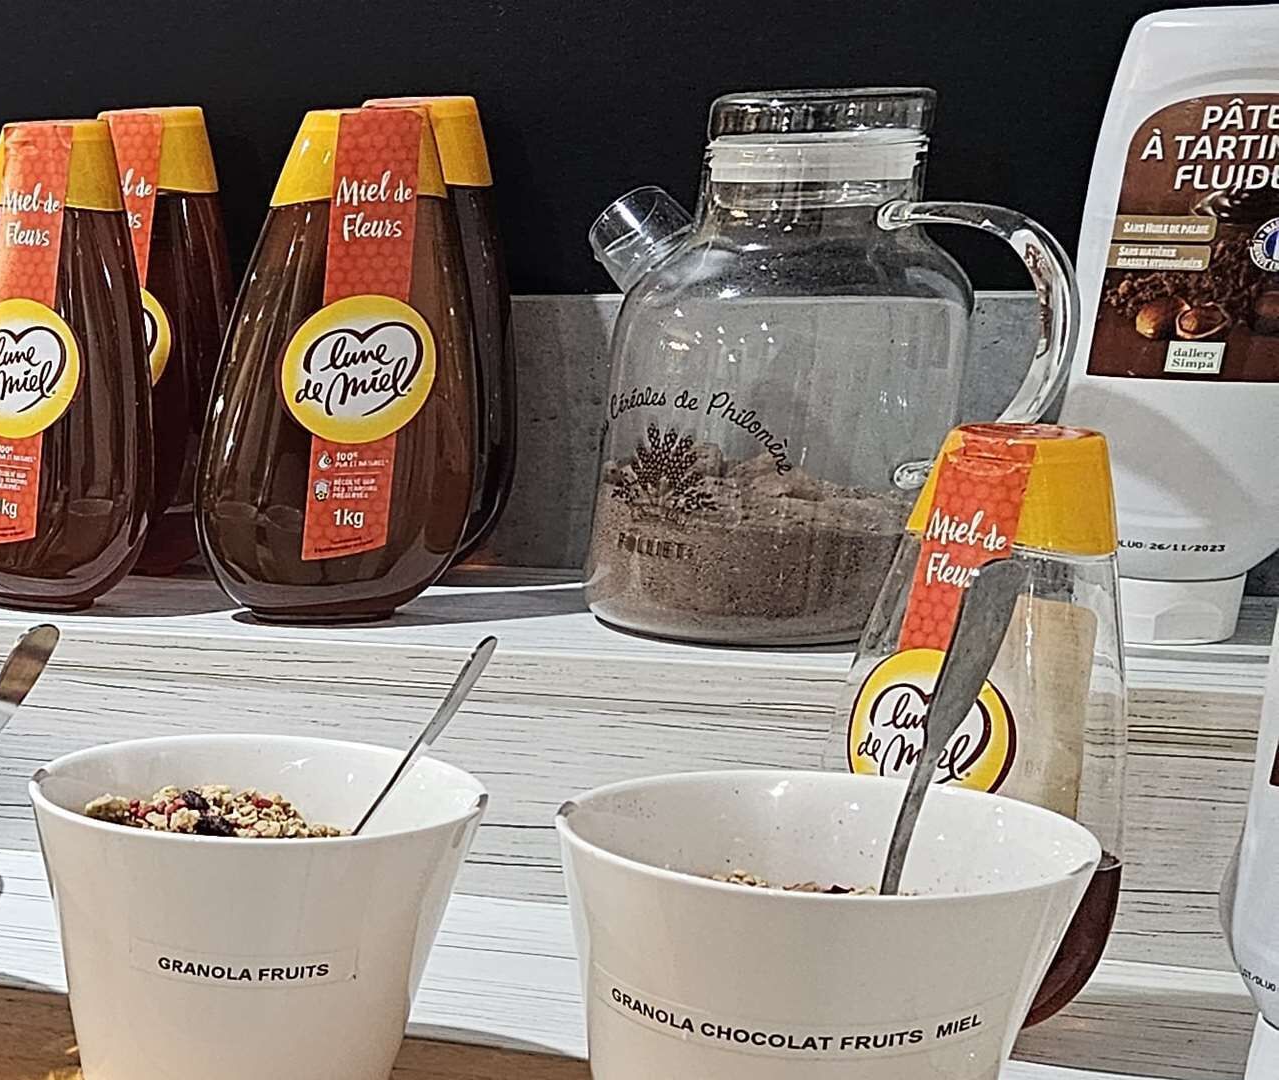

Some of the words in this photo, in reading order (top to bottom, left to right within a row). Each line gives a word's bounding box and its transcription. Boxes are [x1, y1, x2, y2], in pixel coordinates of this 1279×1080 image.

[1201, 97, 1279, 130] PÂTE
[1140, 127, 1164, 160] À
[1, 182, 41, 215] Miel
[43, 193, 61, 213] de
[134, 174, 154, 198] de
[336, 171, 391, 208] Miel
[393, 183, 414, 203] de
[4, 216, 50, 247] Fleurs
[341, 214, 403, 243] Fleurs
[320, 335, 395, 372] lune
[1171, 358, 1215, 370] Simpa
[1172, 347, 1217, 360] dallery
[295, 376, 324, 405] de
[324, 364, 411, 418] miel
[610, 387, 666, 420] Céréales
[673, 390, 699, 411] de
[706, 391, 792, 476] Philomène
[333, 508, 364, 529] 1kg
[926, 507, 982, 551] Miel
[982, 523, 1008, 552] de
[1149, 542, 1226, 552] 26/11/2023
[857, 731, 884, 762] de
[157, 956, 252, 981] GRANOLA
[258, 963, 330, 981] FRUITS
[611, 987, 695, 1033] GRANOLA
[700, 1021, 834, 1051] CHOCOLAT
[839, 1029, 924, 1051] FRUITS
[935, 1013, 983, 1039] MIEL
